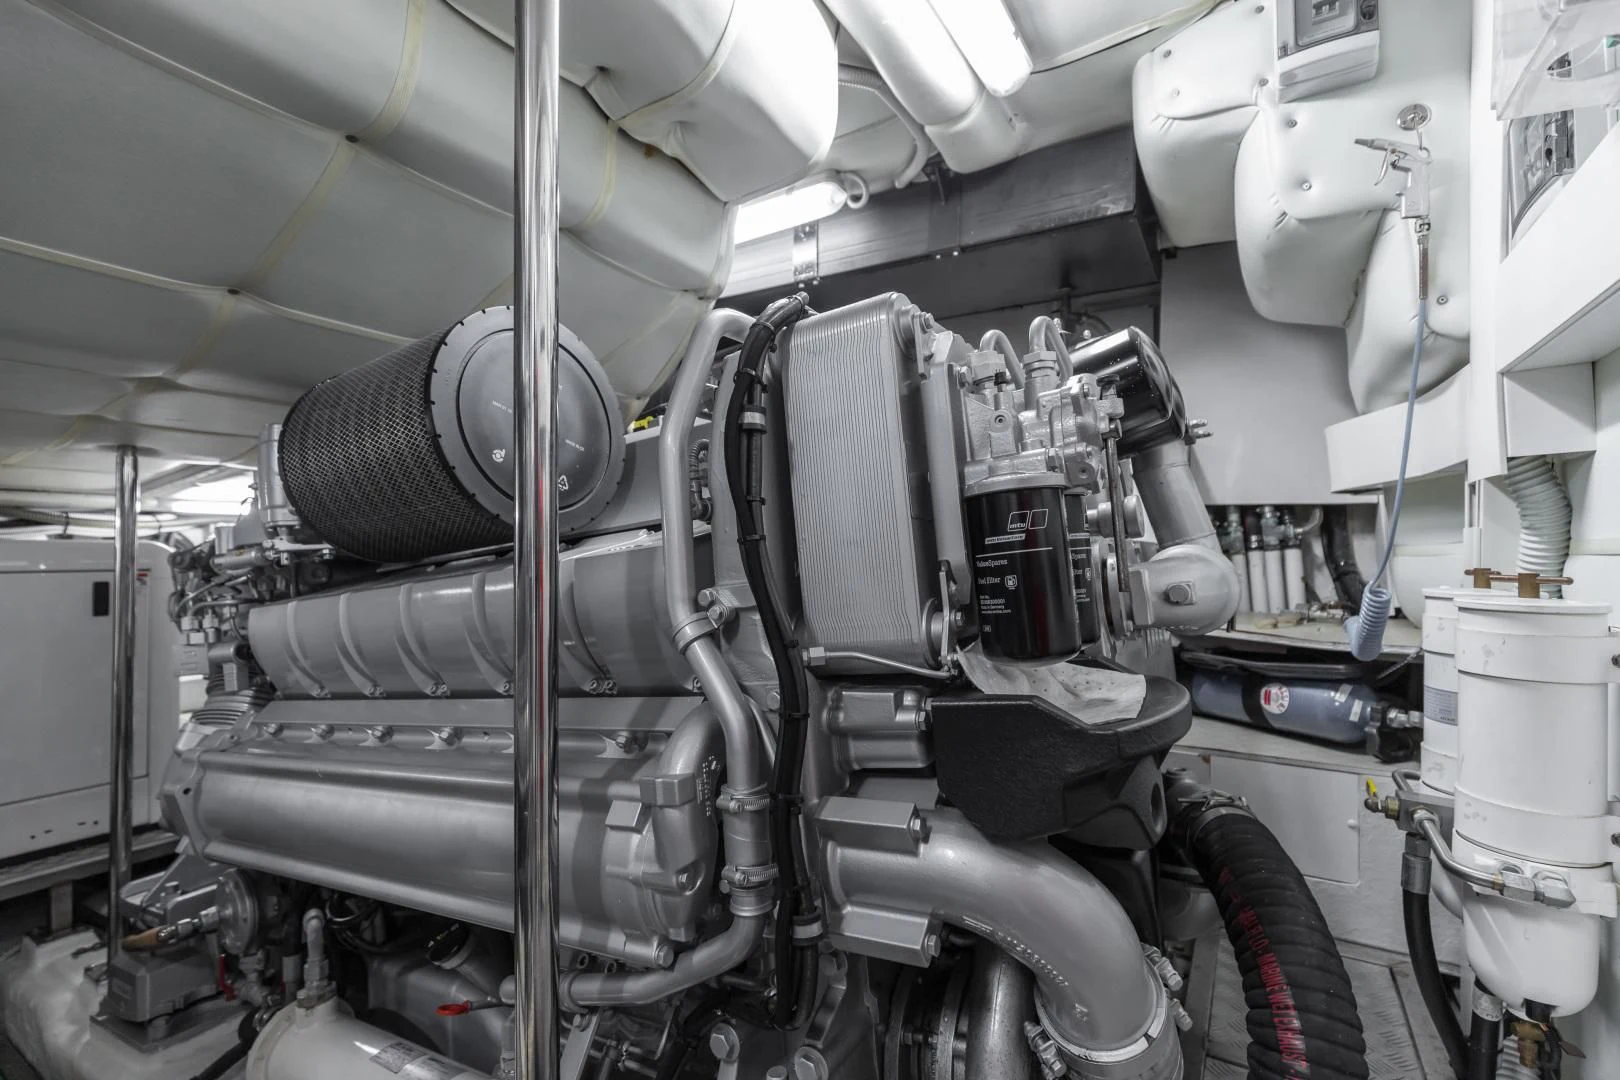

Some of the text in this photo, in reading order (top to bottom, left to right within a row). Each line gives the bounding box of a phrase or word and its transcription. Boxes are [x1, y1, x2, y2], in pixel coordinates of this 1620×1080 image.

[1257, 952, 1290, 992] MARINE
[1267, 989, 1296, 1014] WET
[1272, 1014, 1308, 1068] EXHAUST
